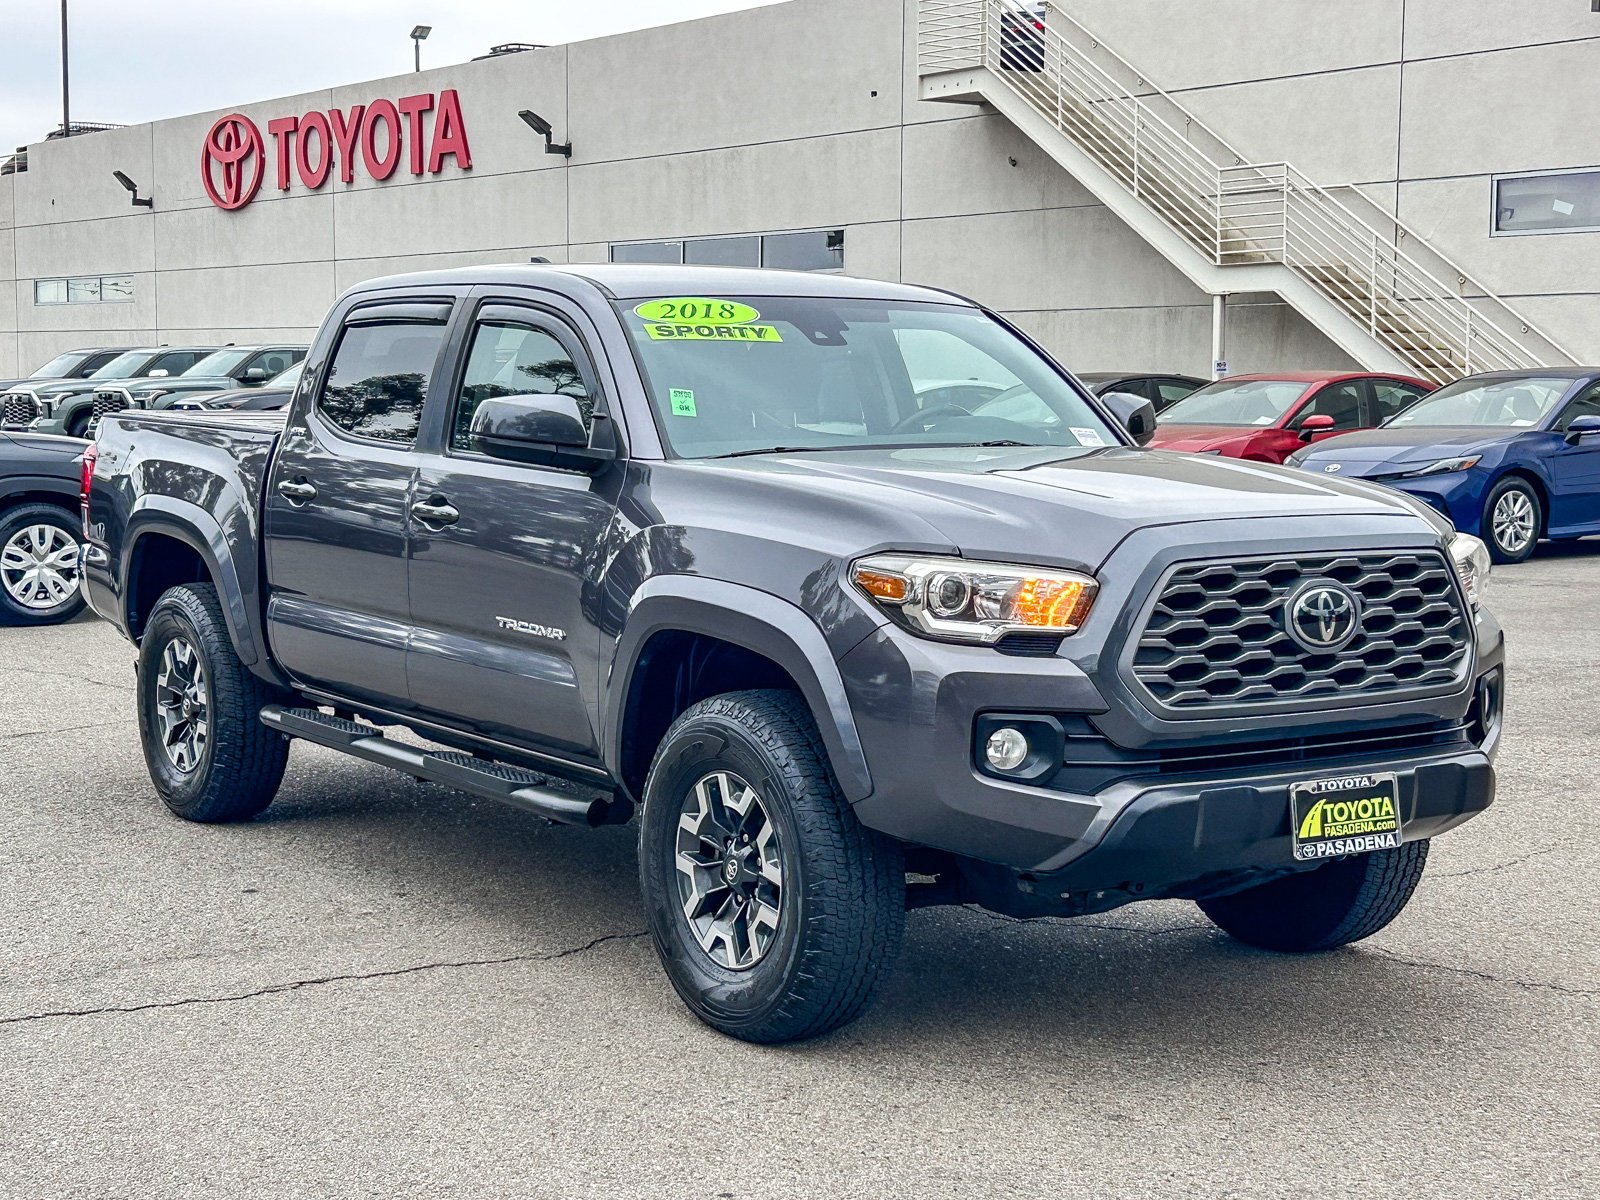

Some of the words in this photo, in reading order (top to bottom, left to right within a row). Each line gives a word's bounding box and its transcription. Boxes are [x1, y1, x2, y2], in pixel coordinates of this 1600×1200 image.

[268, 89, 472, 192] TOYOTA
[660, 303, 735, 319] 2018
[655, 325, 768, 338] SPORTY
[495, 616, 567, 640] TACOMA
[1318, 777, 1370, 791] TOYOTA
[1323, 797, 1394, 823] TOYOTA
[1324, 820, 1396, 837] PASADENA.com
[1317, 834, 1396, 856] PASADENA
